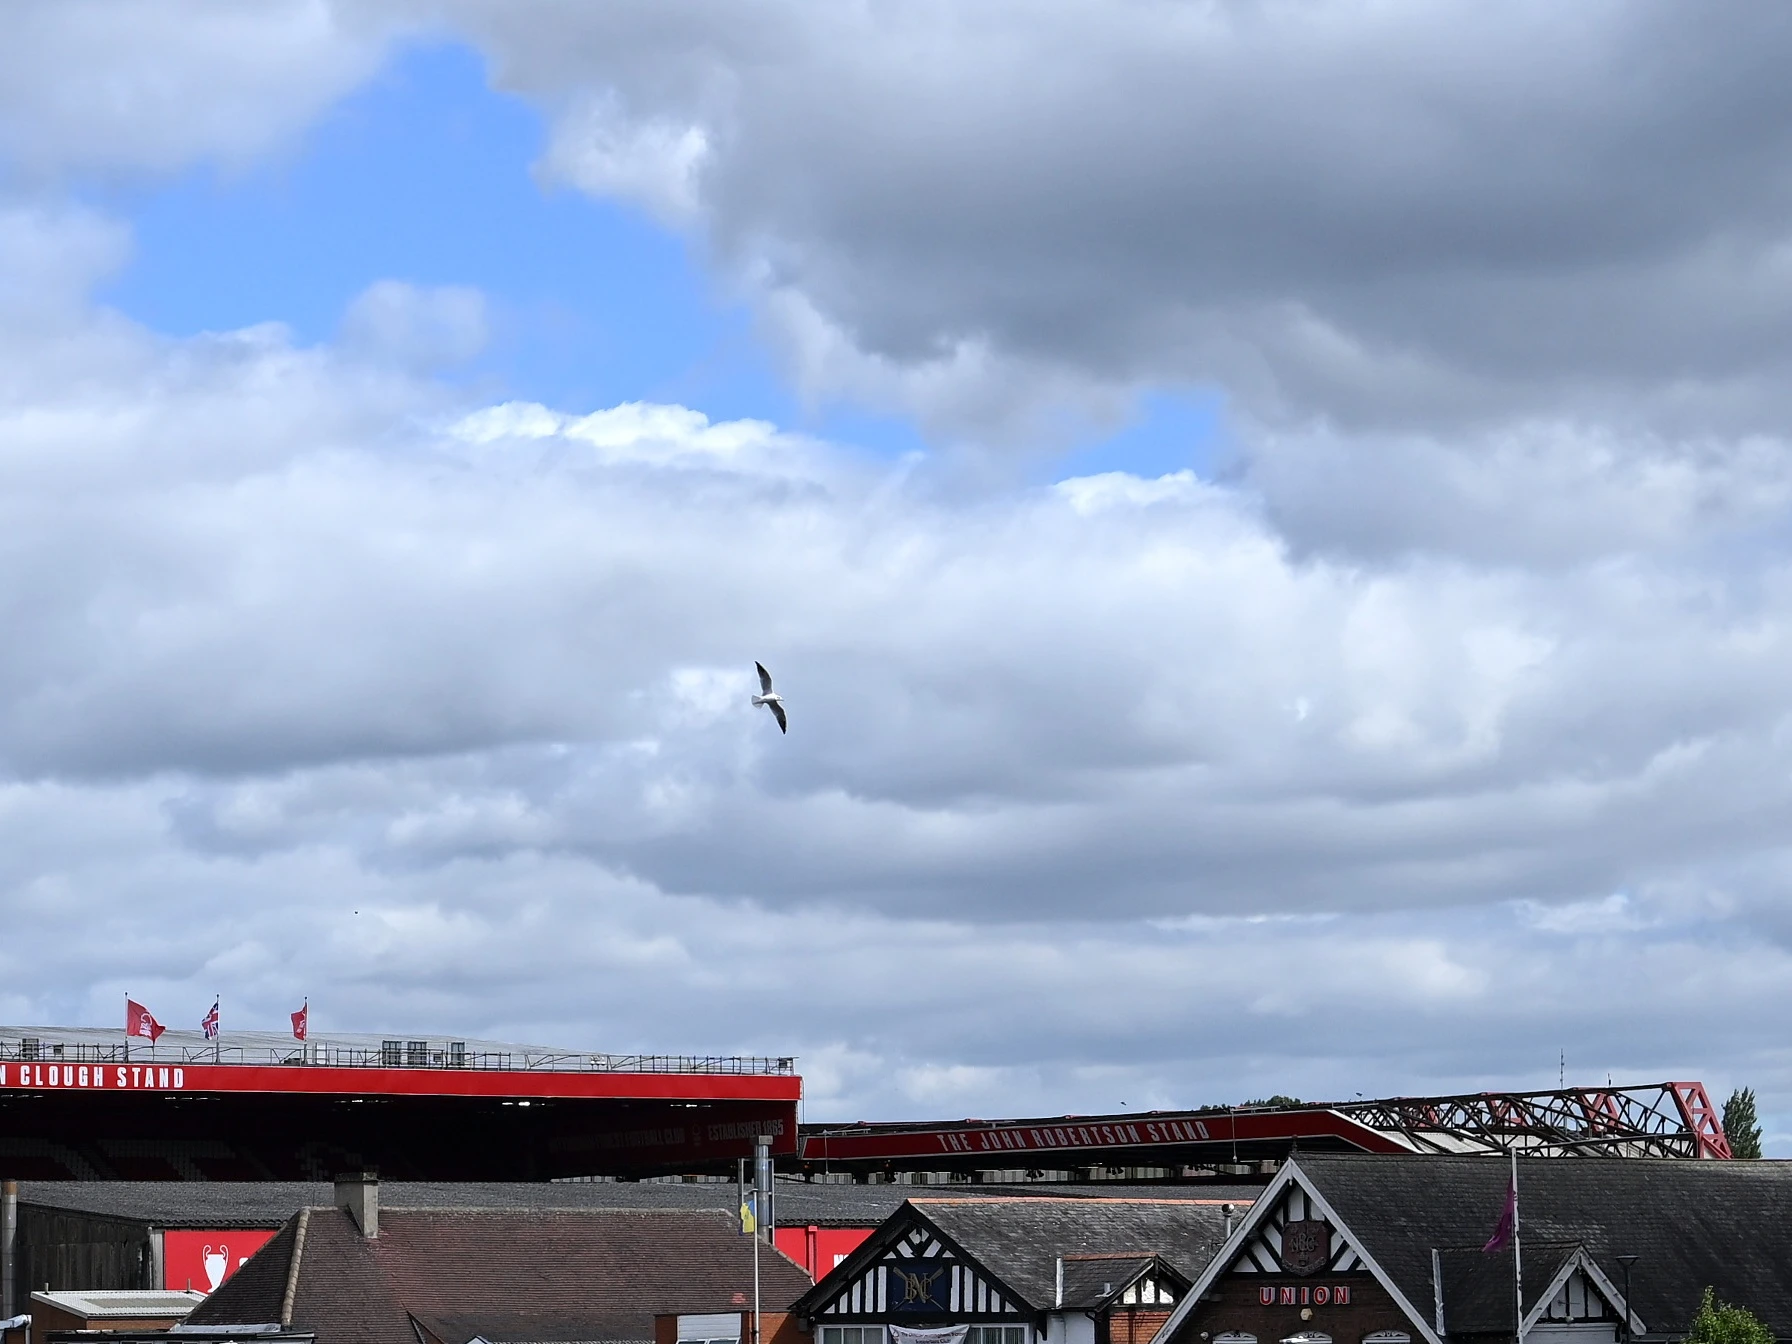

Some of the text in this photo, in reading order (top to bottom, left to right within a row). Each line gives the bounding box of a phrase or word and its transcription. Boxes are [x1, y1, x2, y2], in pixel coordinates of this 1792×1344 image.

[20, 1065, 104, 1087] CLOUGH
[117, 1066, 184, 1088] STAND
[708, 1119, 784, 1141] ESTABLISHED 1865
[937, 1121, 1210, 1152] THE JOHN ROBERTSON STAND
[1259, 1286, 1351, 1305] UNION
